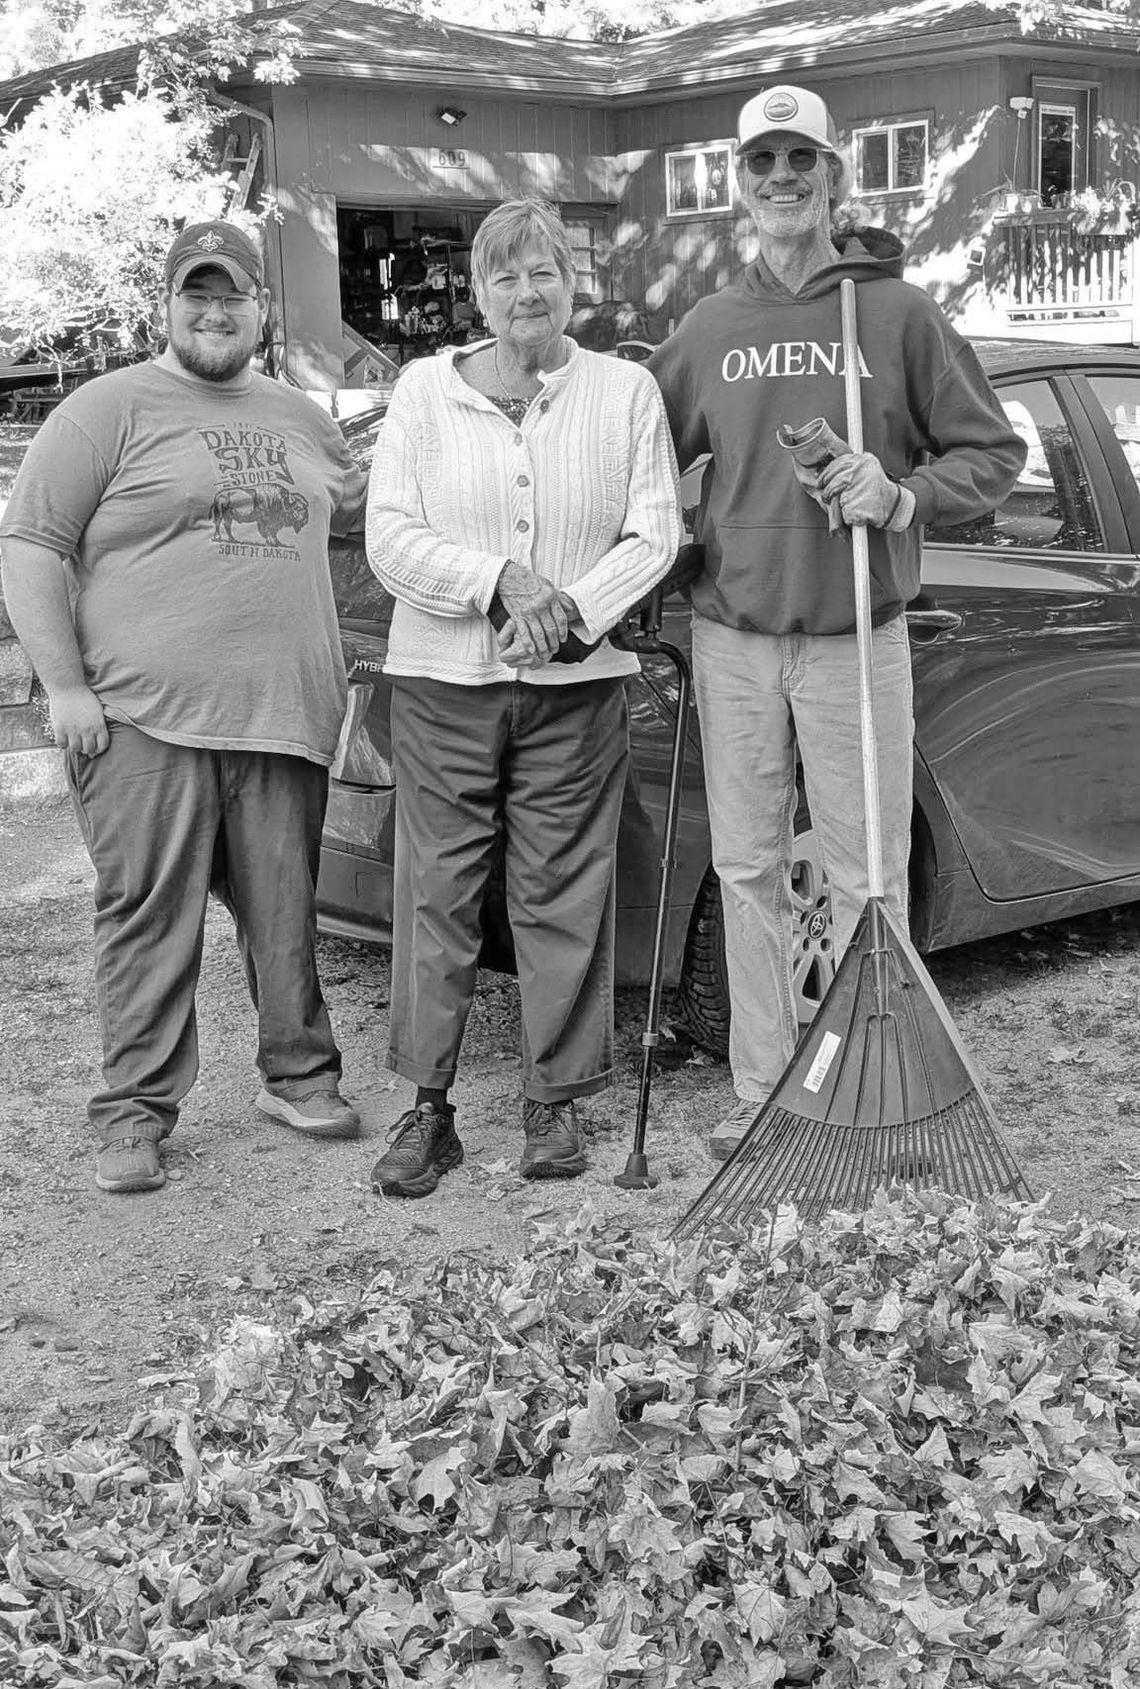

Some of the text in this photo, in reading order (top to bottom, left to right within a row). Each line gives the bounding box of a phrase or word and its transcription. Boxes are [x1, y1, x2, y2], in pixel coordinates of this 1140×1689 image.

[438, 150, 466, 167] 609
[198, 430, 286, 452] DAKOTA
[214, 446, 295, 486] SKY
[230, 470, 277, 486] STONE
[218, 544, 302, 562] SOUTH DAKOTA
